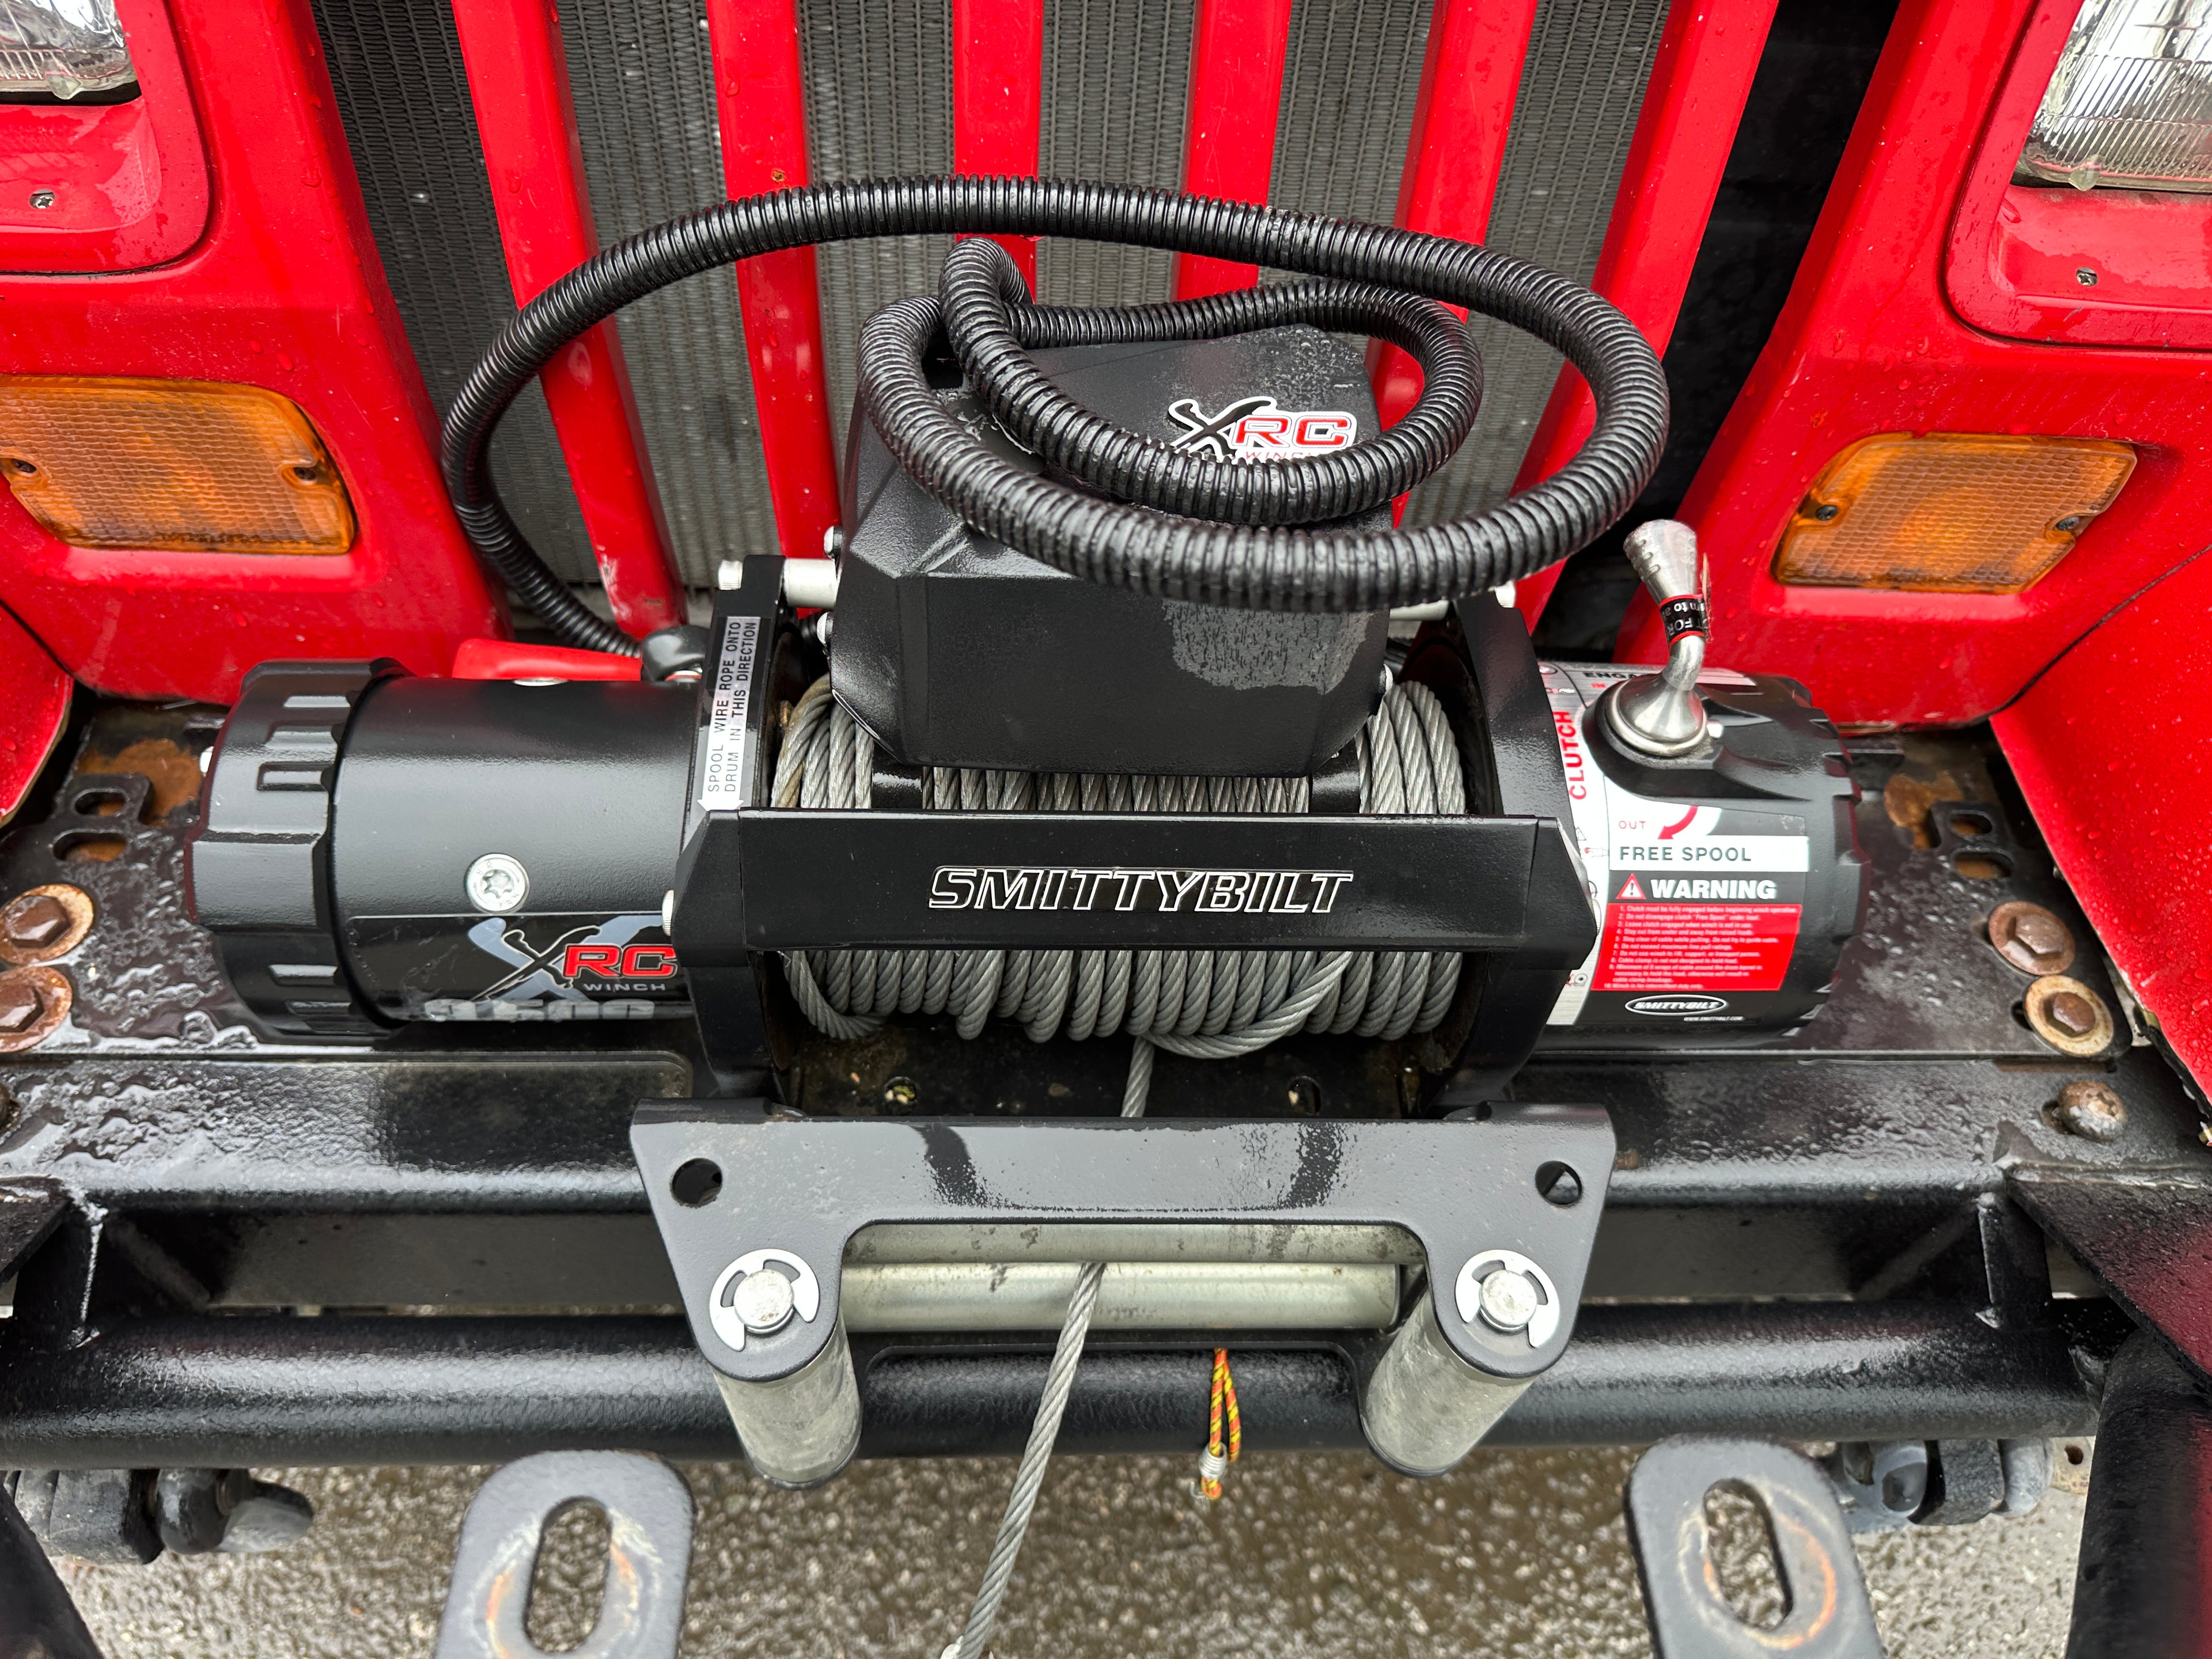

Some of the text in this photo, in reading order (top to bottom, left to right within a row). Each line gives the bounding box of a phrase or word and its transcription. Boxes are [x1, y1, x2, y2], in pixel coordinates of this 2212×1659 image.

[1246, 451, 1320, 460] WINC
[1673, 602, 1688, 612] to
[709, 622, 741, 792] SPOOL WIRE ROPE ONTO
[724, 622, 756, 792] DRUM IN THIS DIRECTION
[1552, 711, 1586, 800] CLUTCH
[1618, 820, 1646, 830] OUT
[1619, 846, 1752, 862] FREE SPOOL
[928, 866, 1354, 914] SMITTYBILT
[1650, 878, 1777, 900] WARNING
[584, 983, 666, 992] WINCH
